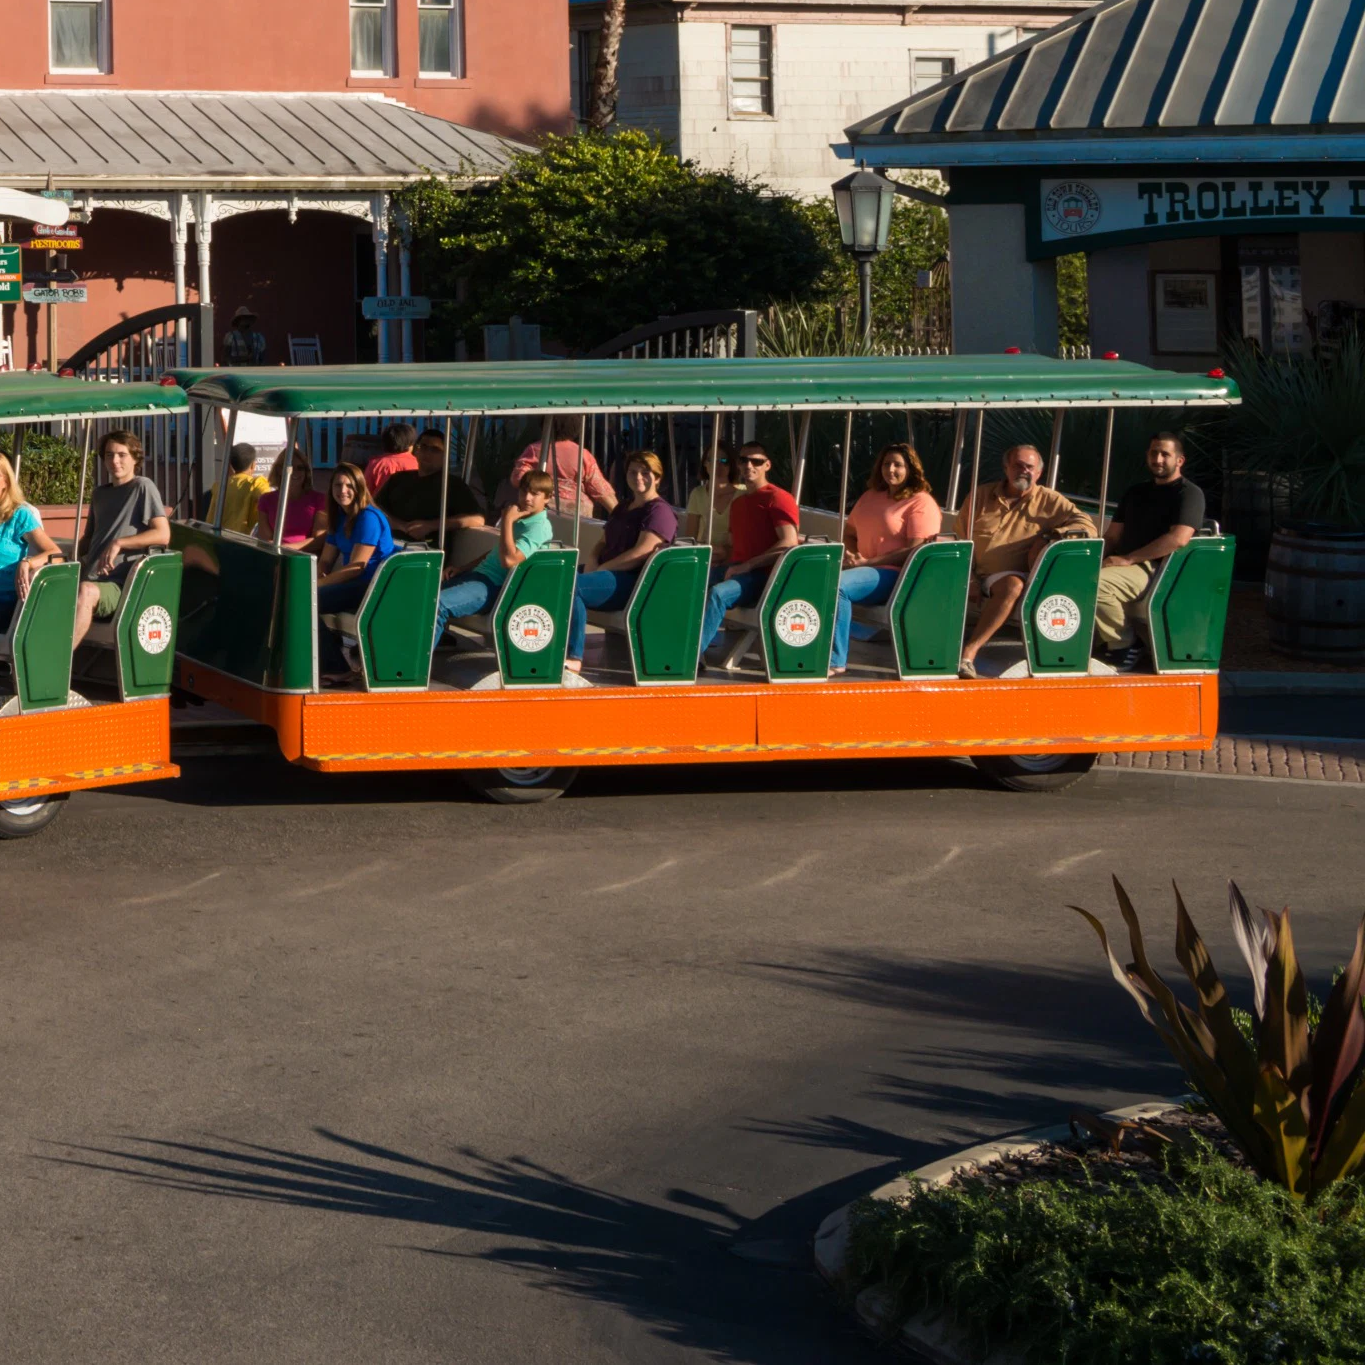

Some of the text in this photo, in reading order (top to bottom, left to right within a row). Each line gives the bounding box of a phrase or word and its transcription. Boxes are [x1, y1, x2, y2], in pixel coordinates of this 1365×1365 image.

[1137, 180, 1330, 226] TROLLEY
[1055, 216, 1094, 232] TOURS
[30, 238, 81, 249] RESTROOMS
[33, 288, 60, 297] GATOR
[377, 298, 395, 308] OLD
